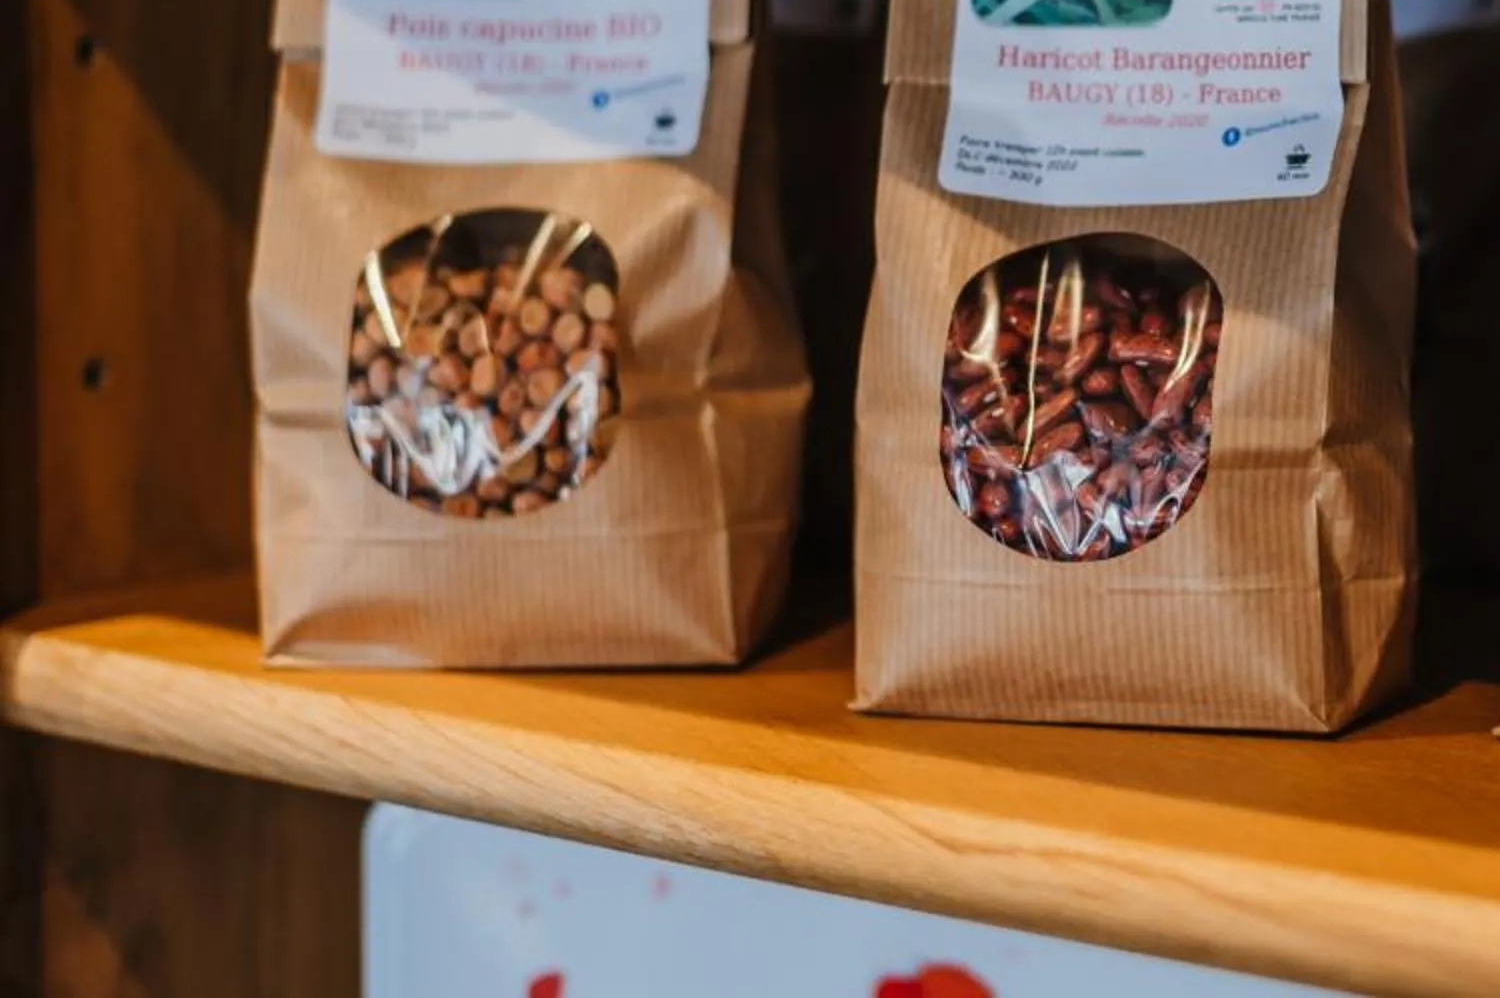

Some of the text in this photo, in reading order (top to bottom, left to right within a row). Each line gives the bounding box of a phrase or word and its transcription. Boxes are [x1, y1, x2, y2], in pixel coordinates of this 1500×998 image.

[387, 10, 662, 44] Pois capucine BIO
[998, 44, 1312, 76] Haricot Barangeonnier
[1028, 81, 1118, 104] BAUGY
[1126, 83, 1175, 106] (18)
[1199, 83, 1282, 104] France
